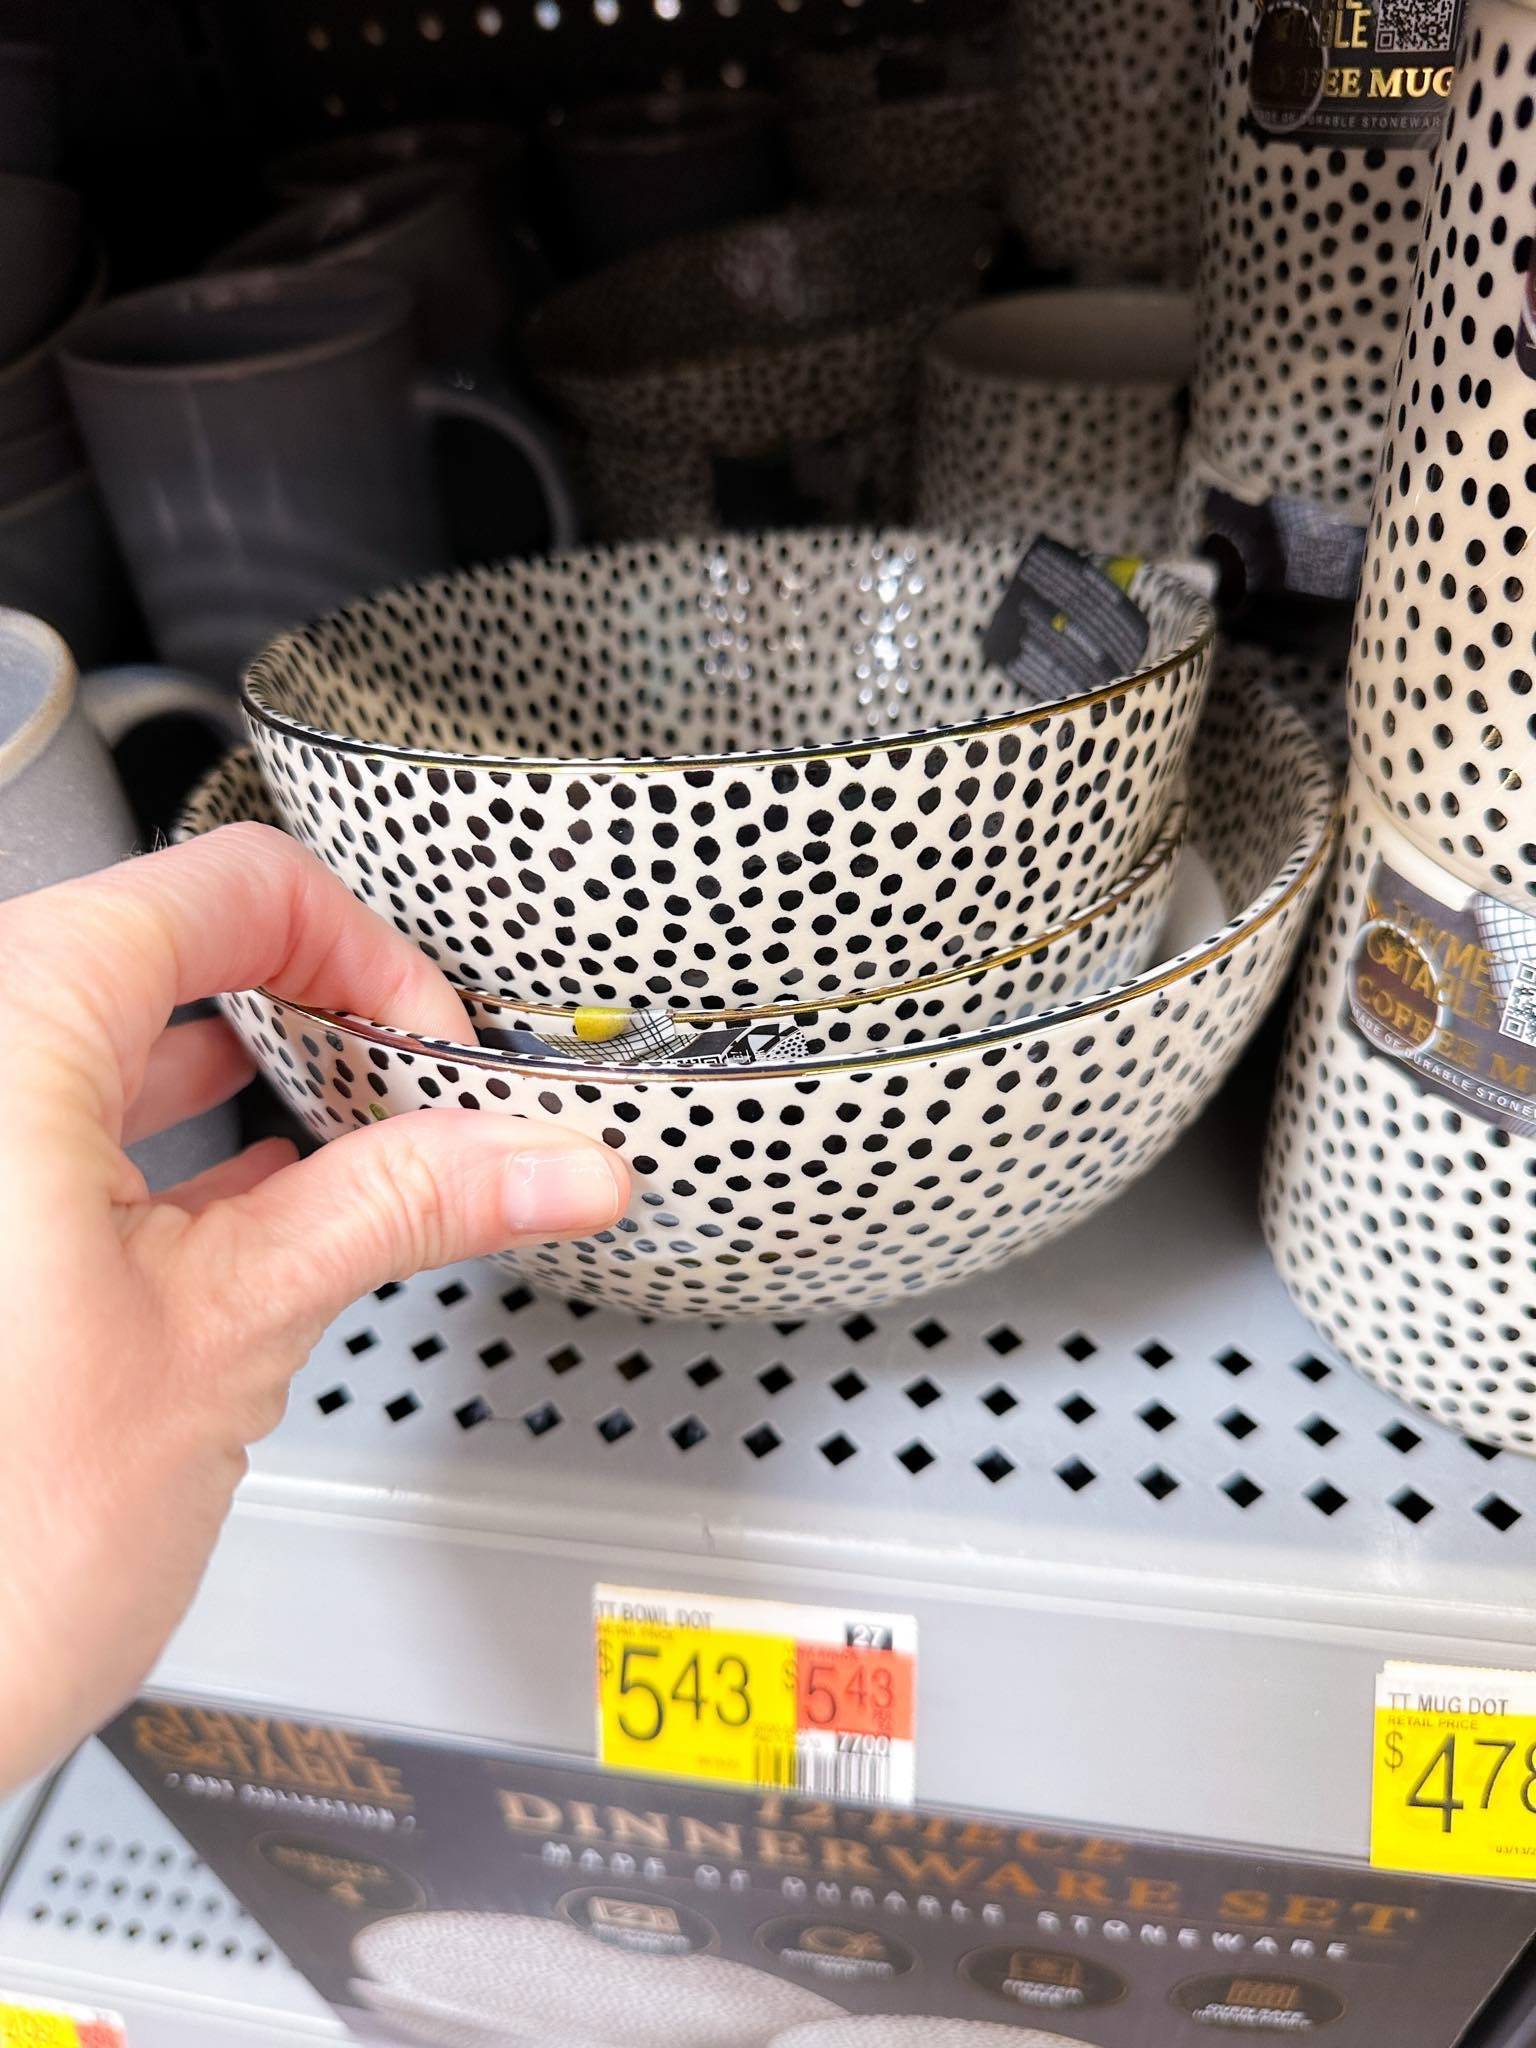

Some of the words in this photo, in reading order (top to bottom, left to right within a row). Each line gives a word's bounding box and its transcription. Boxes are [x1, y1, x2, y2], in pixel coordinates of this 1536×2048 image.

[1384, 1032, 1402, 1049] OF
[1404, 1047, 1471, 1092] DURABLE
[1475, 1086, 1536, 1118] STONE
[1487, 1050, 1531, 1093] M
[622, 1602, 672, 1626] BOWL
[678, 1608, 713, 1632] DOT
[853, 1624, 884, 1647] 27
[1387, 1692, 1411, 1711] TT
[1417, 1694, 1461, 1713] MUG
[1467, 1697, 1509, 1717] DOT
[1387, 1715, 1433, 1728] RETAIL
[1438, 1718, 1479, 1730] PRICE
[498, 1788, 1181, 1911] DINNERWARE
[1218, 1889, 1418, 1936] SET
[541, 1840, 667, 1881] MADE
[693, 1863, 751, 1894] OF
[1036, 1909, 1350, 1962] STONEWARE
